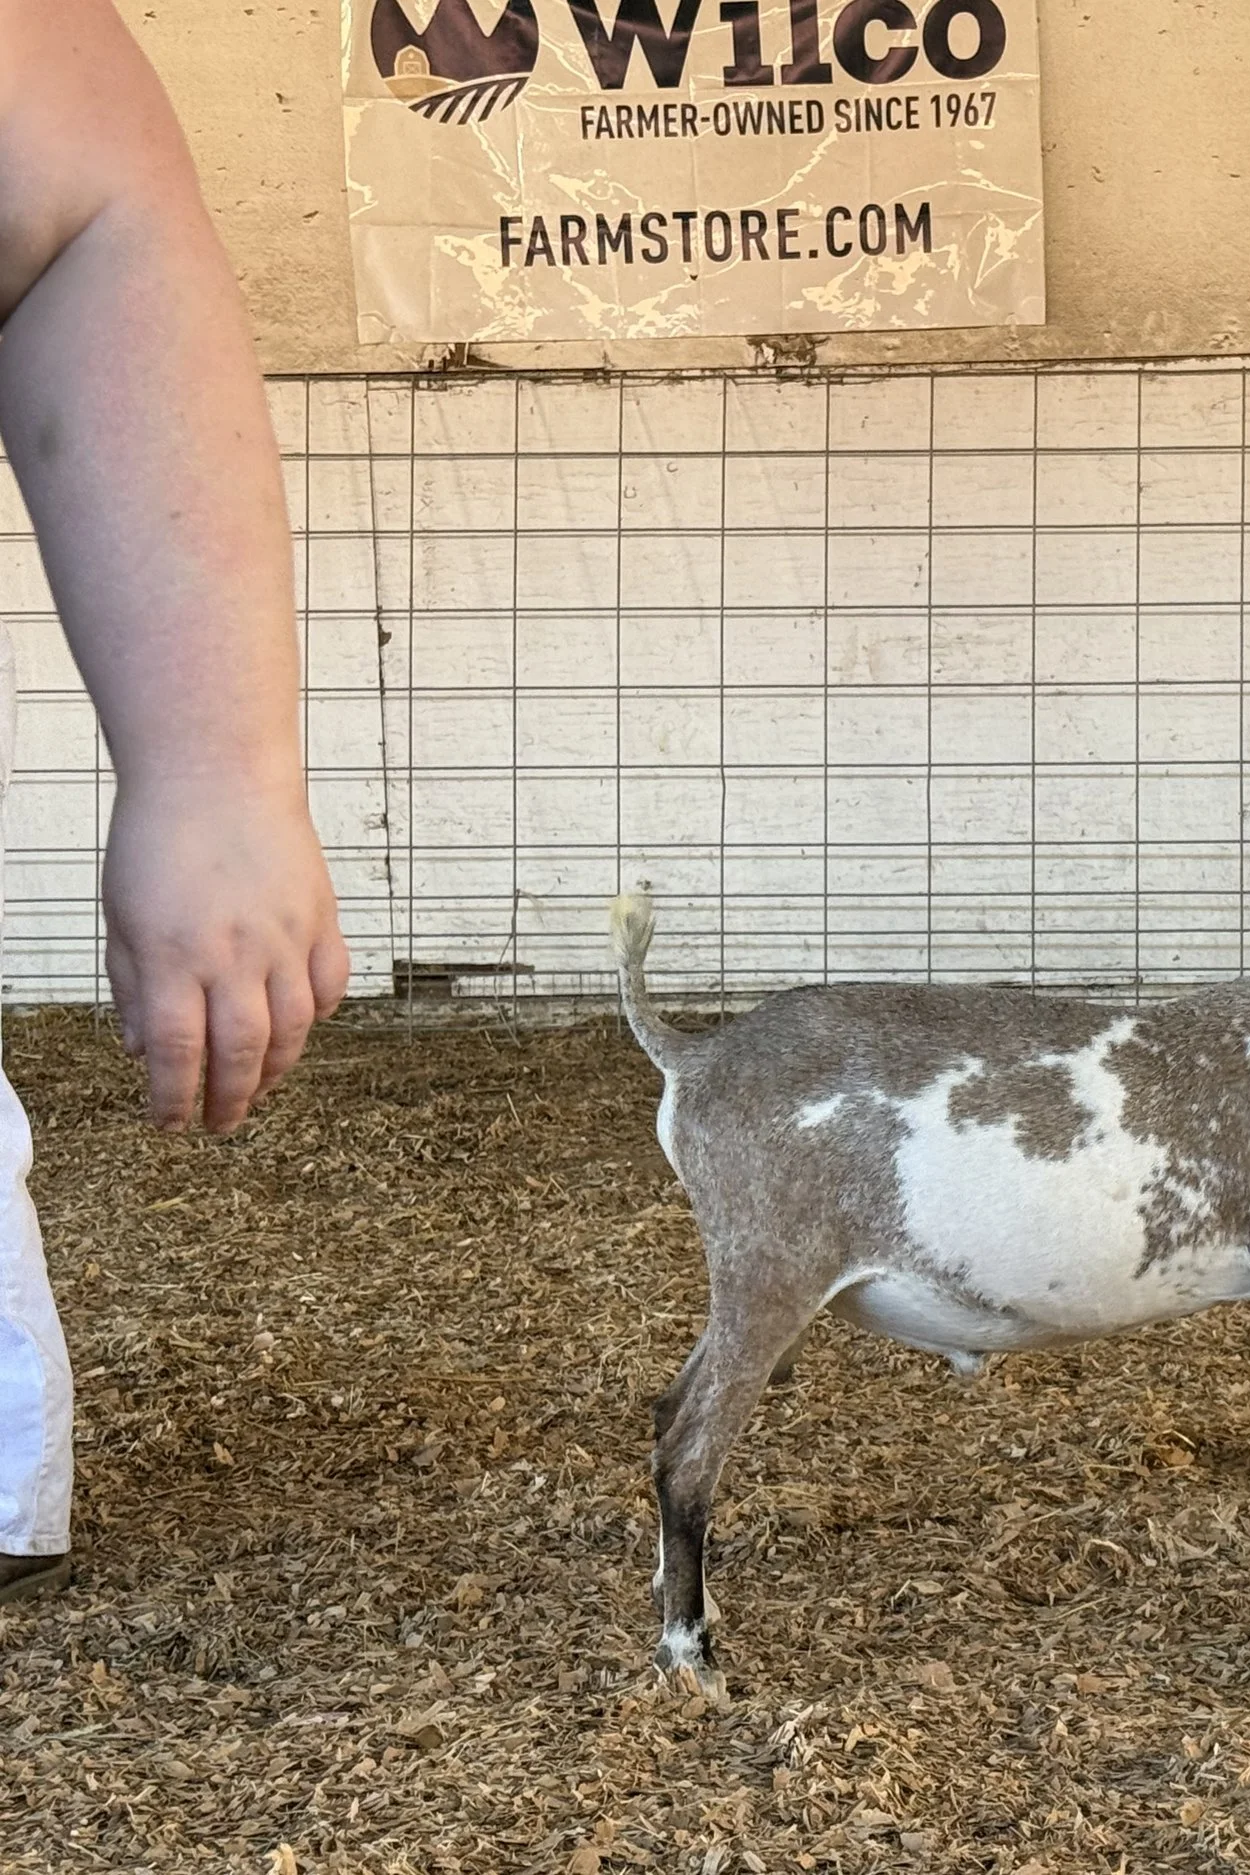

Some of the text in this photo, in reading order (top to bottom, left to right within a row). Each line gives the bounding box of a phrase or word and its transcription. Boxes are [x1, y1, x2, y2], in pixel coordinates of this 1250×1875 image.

[566, 0, 1007, 90] Wilco
[580, 91, 997, 140] FARMER-OWNED SINCE 1967
[499, 202, 932, 267] FARMSTORE.COM
